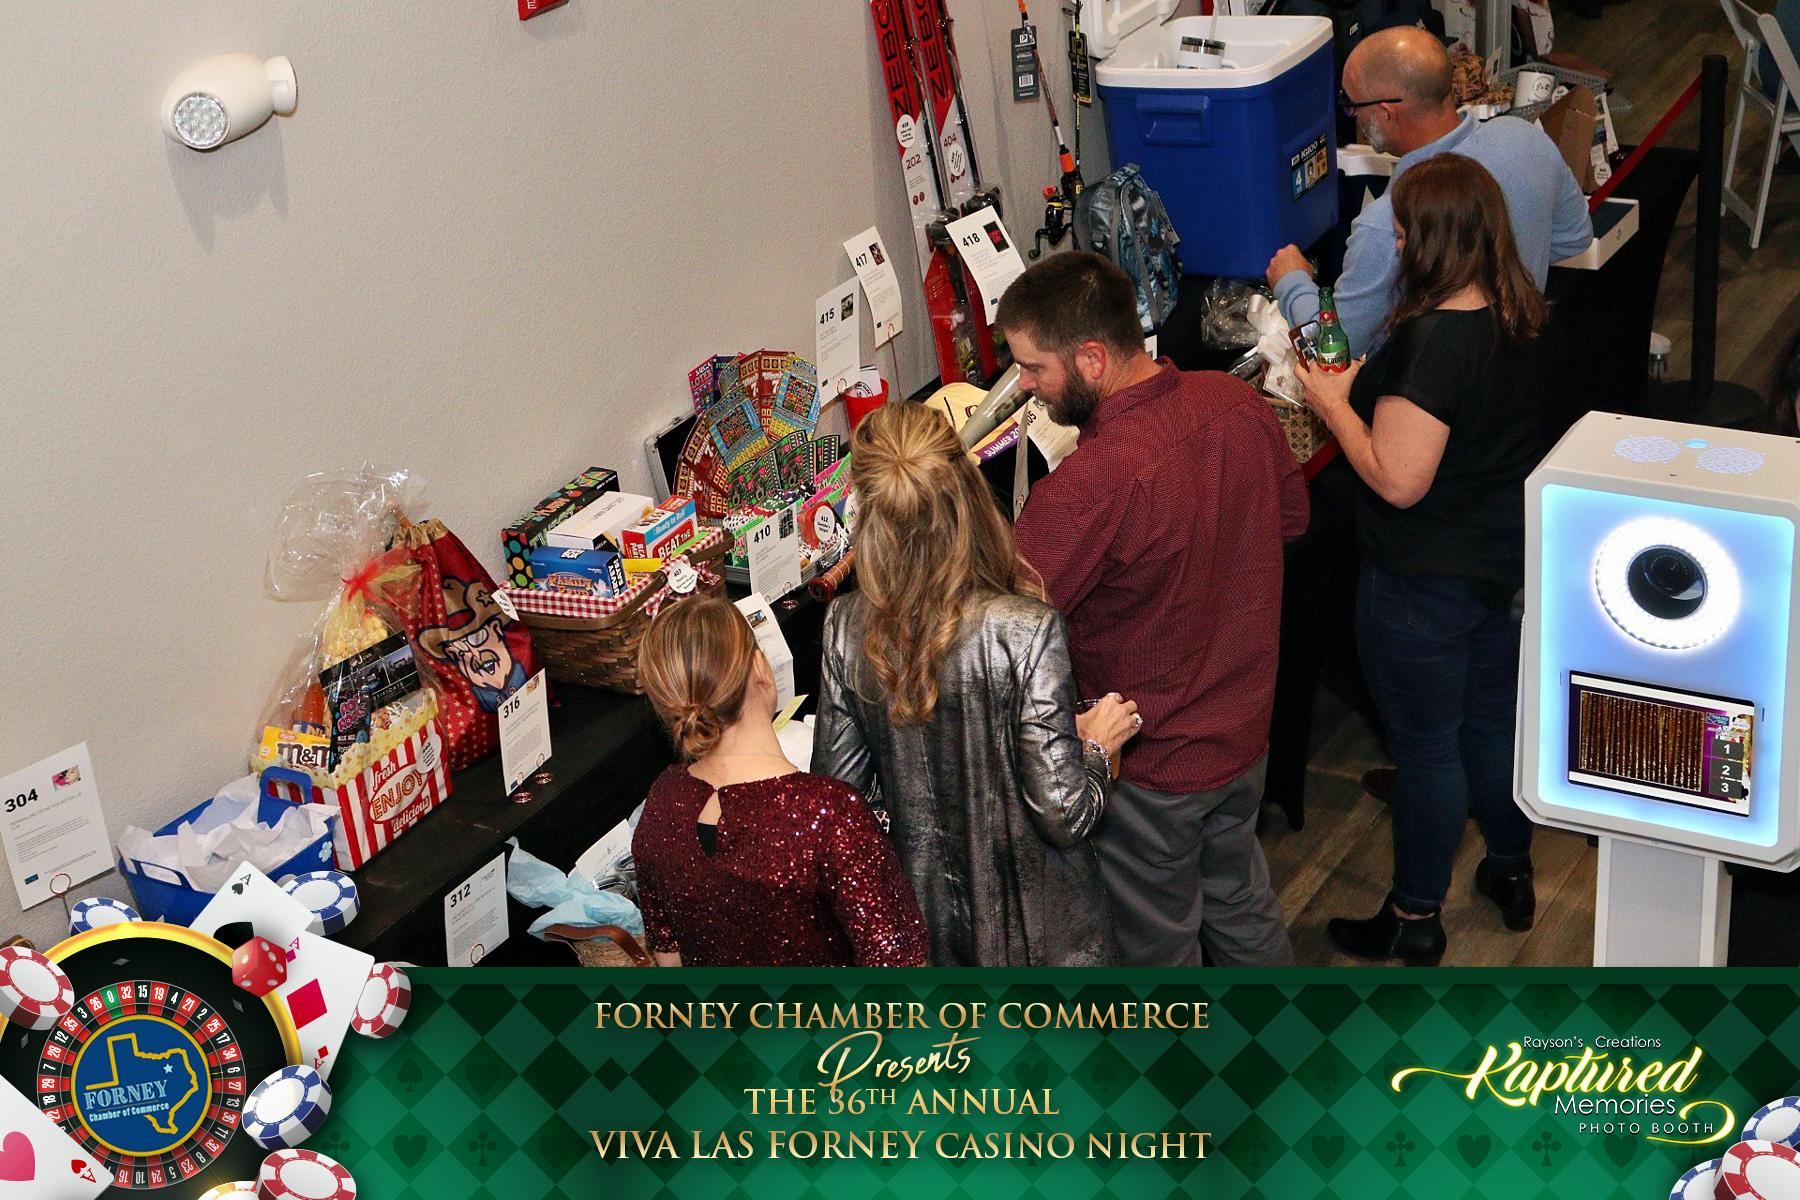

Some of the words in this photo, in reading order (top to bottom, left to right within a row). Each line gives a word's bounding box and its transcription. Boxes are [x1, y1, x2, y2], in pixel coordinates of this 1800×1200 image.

[906, 153, 921, 169] 202
[962, 233, 981, 248] 418
[855, 253, 867, 268] 417
[819, 310, 835, 324] 415
[984, 435, 1013, 457] SUMMER
[753, 523, 771, 544] 410
[658, 535, 681, 562] BEAT
[681, 529, 691, 542] THE
[503, 697, 520, 718] 316
[1723, 744, 1730, 755] 1
[374, 760, 396, 790] fresh
[1721, 765, 1731, 776] 2
[1721, 782, 1729, 793] 3
[4, 788, 39, 813] 304
[450, 883, 471, 908] 312
